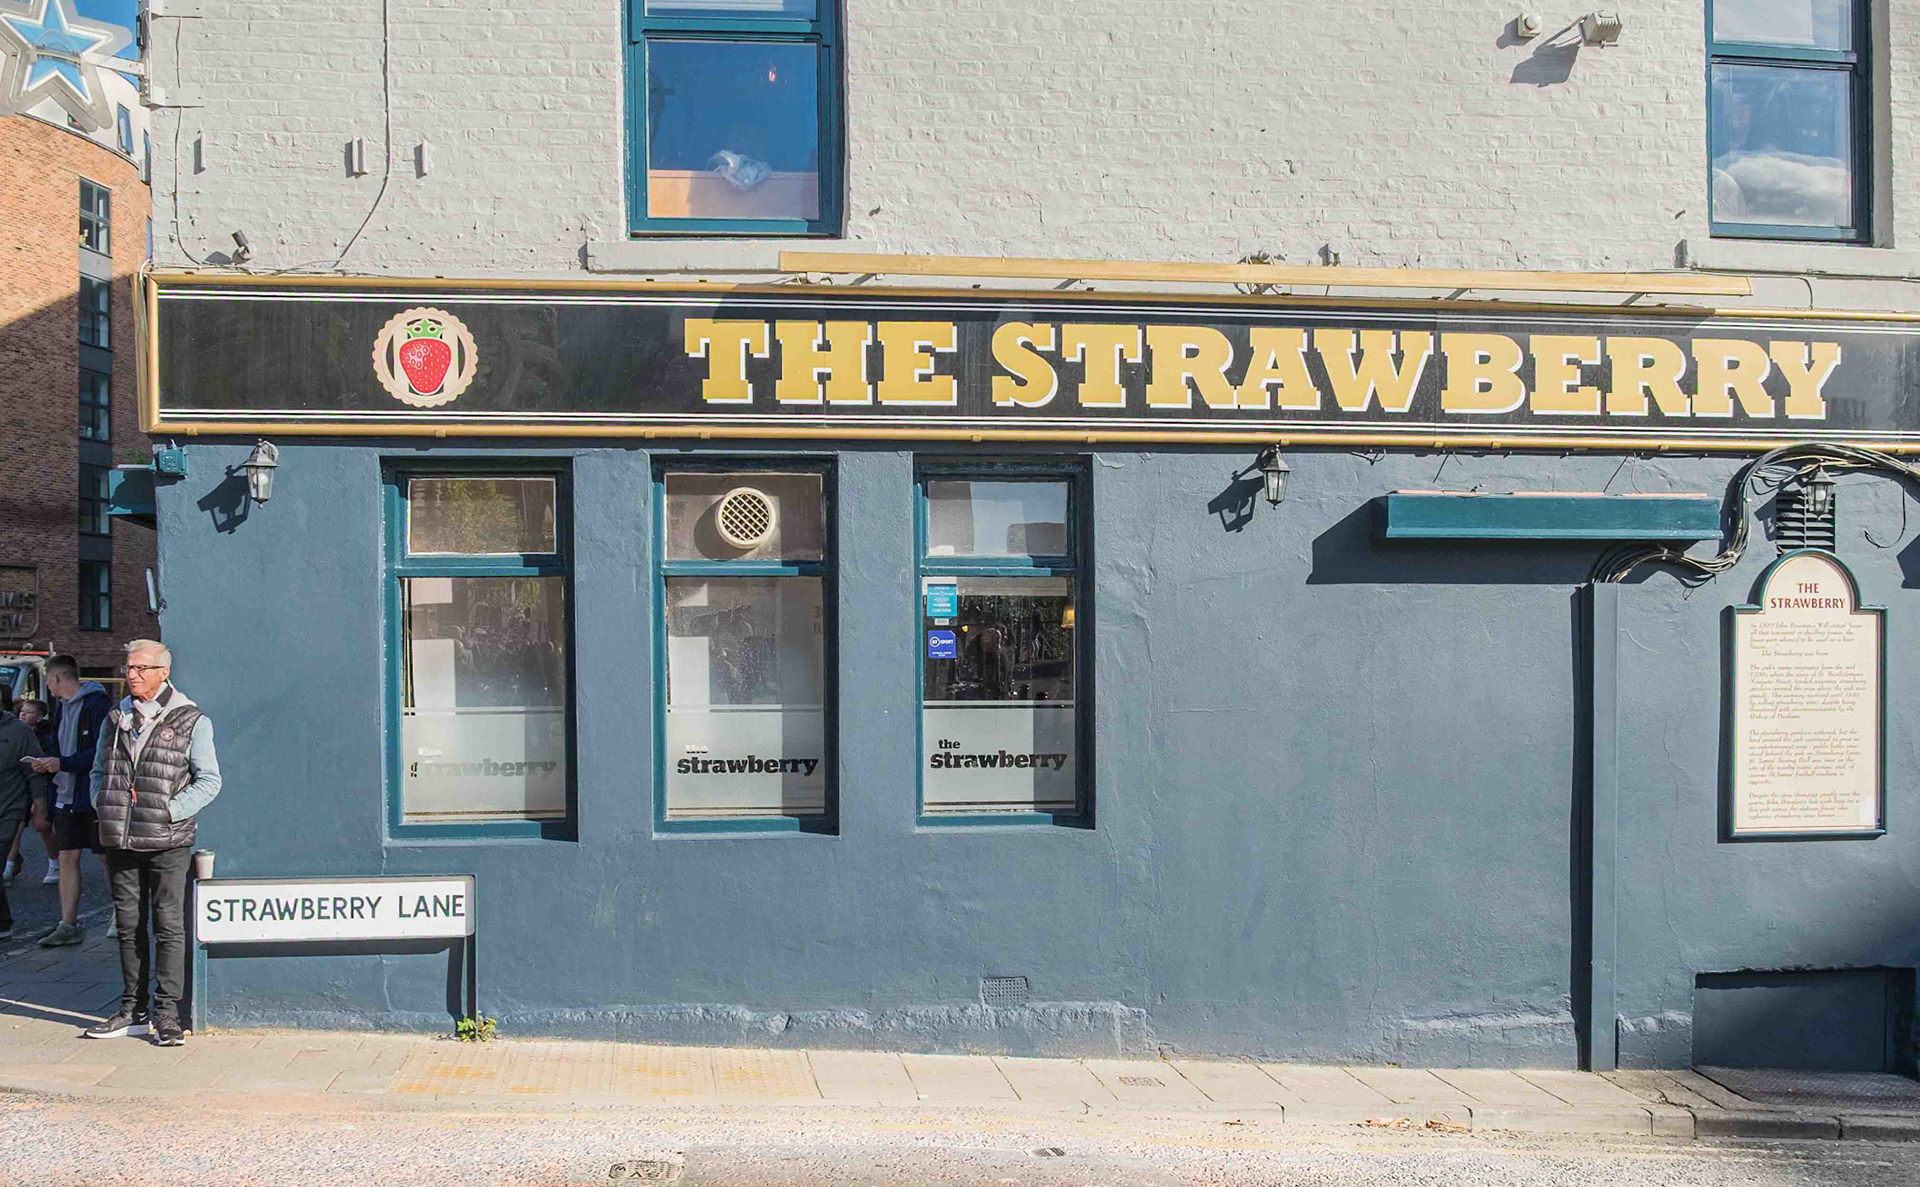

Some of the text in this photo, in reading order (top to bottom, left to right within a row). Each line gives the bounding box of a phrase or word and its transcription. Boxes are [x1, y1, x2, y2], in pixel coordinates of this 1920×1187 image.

[684, 318, 1843, 420] THE STRAWBERRY
[1797, 582, 1819, 593] THE
[1770, 597, 1846, 609] STRAWBERRY
[938, 739, 961, 749] the
[677, 755, 819, 776] strawberry
[930, 750, 1068, 771] strawberry
[206, 894, 466, 922] STRAWBERRY LANE
